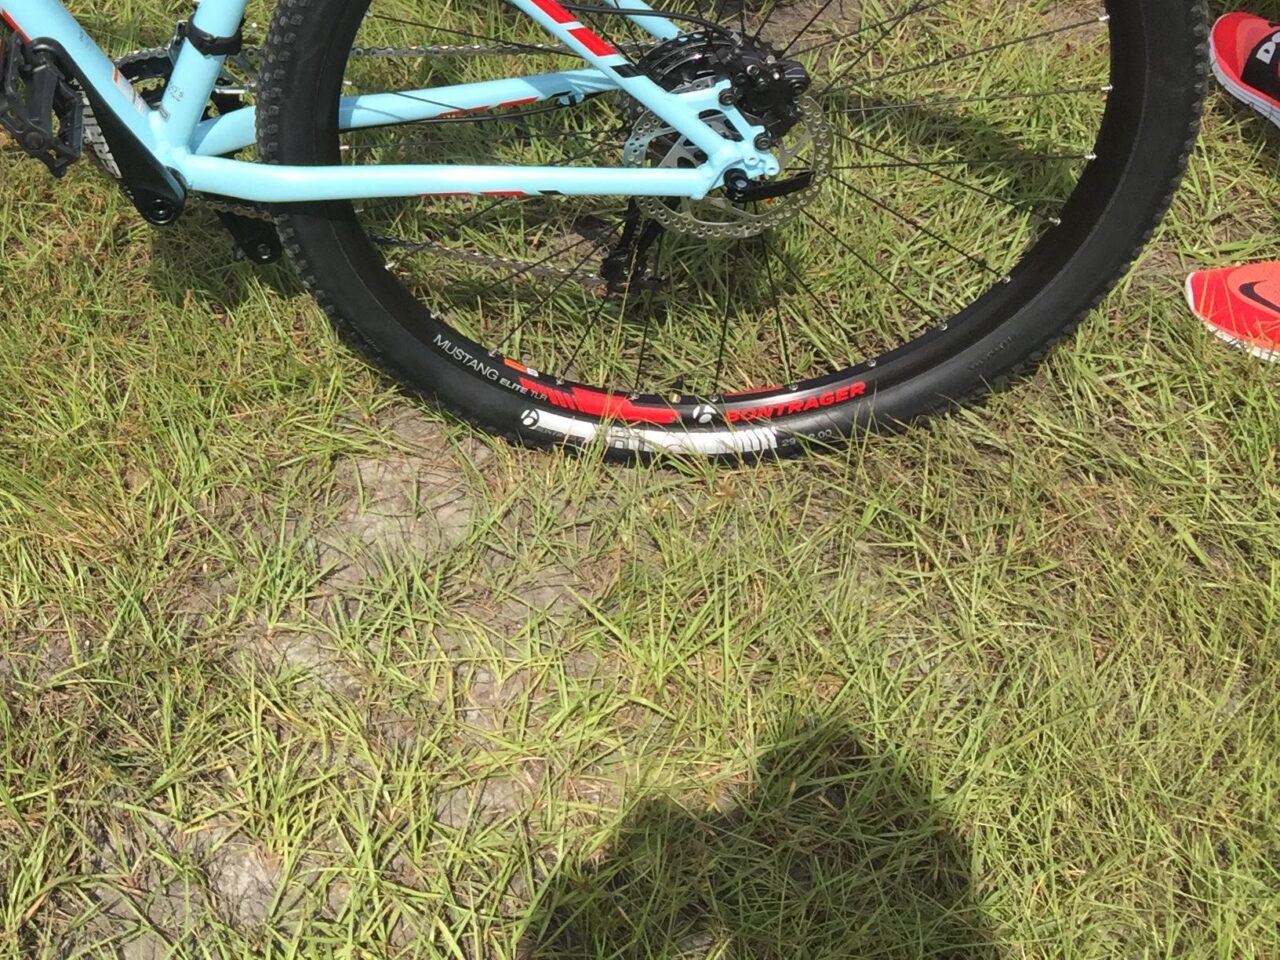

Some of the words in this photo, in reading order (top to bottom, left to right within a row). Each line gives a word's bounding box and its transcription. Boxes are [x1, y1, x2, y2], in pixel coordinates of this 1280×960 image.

[433, 334, 499, 381] MUSTANG
[499, 377, 528, 395] ELITE
[724, 381, 866, 423] BONTRAGER
